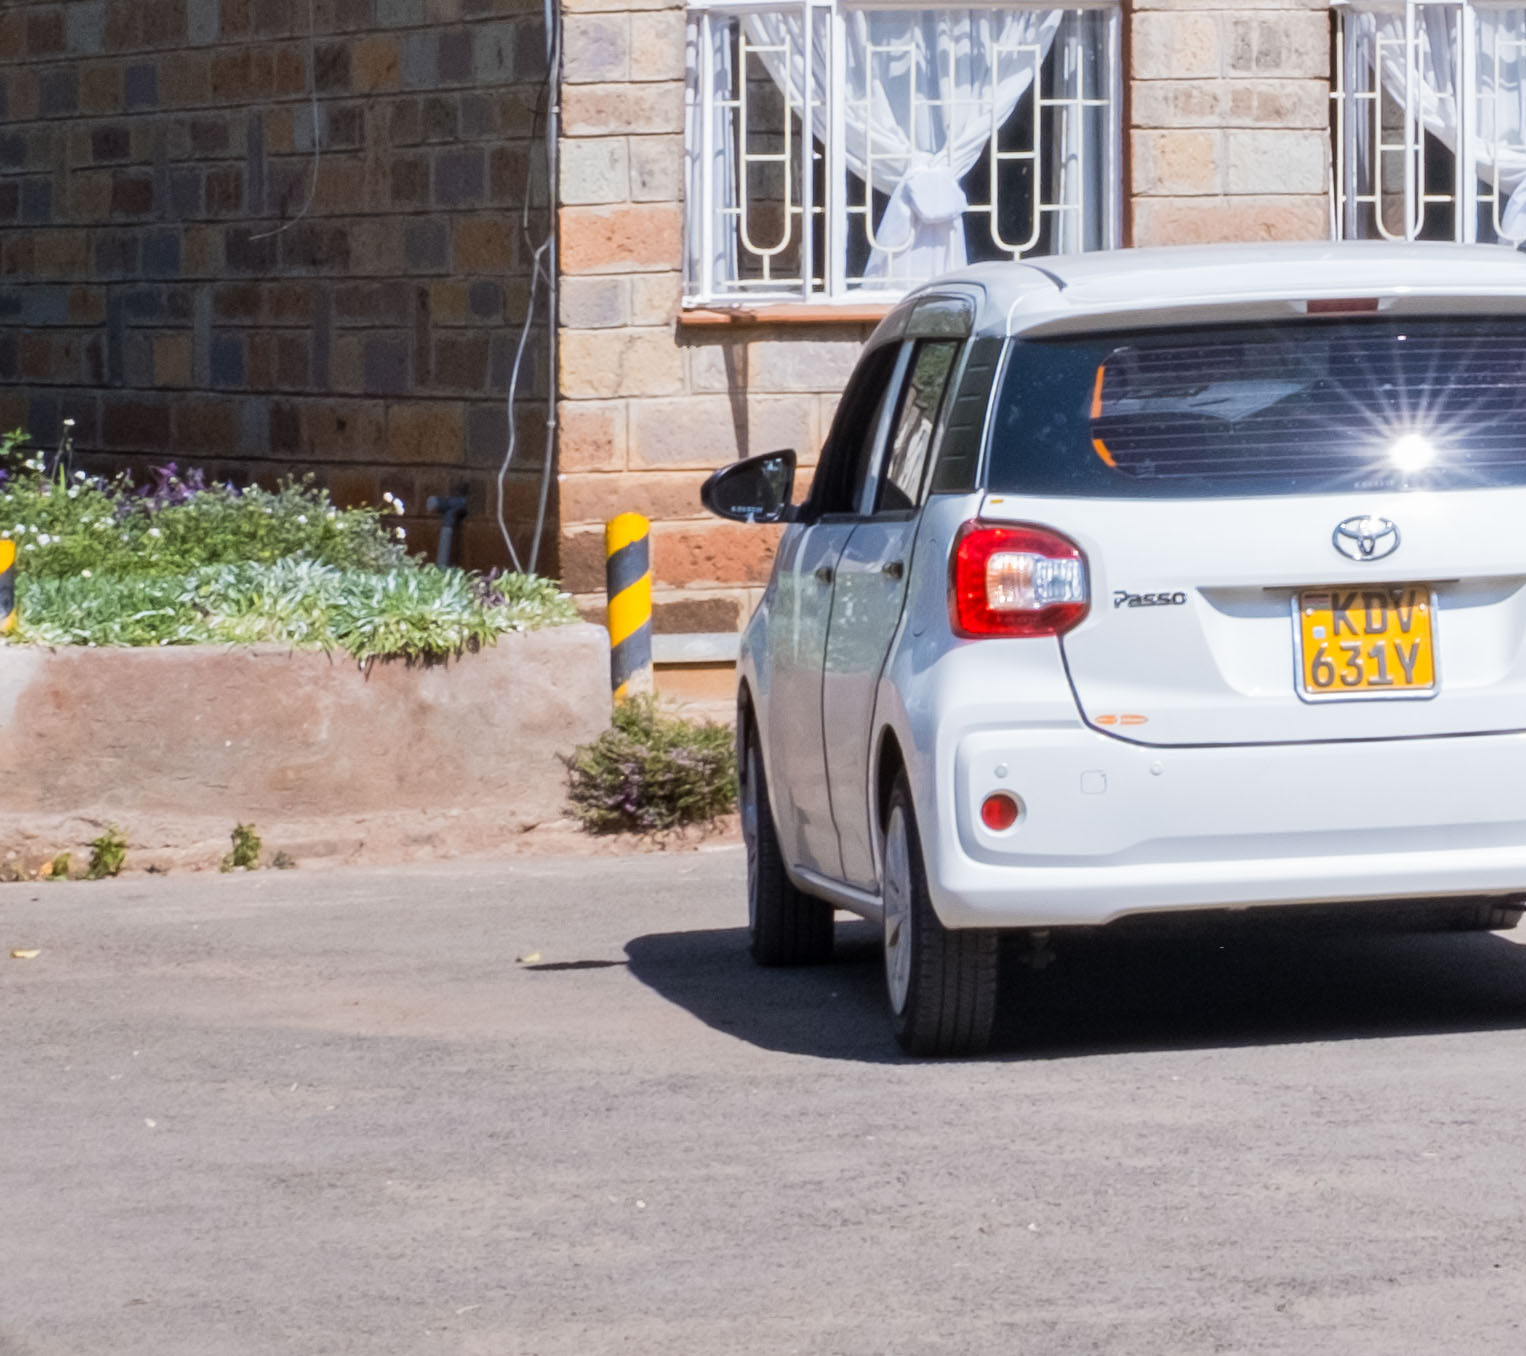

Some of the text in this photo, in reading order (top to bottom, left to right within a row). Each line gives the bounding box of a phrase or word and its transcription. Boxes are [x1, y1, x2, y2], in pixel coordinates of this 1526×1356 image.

[1112, 590, 1186, 608] Passo
[1331, 590, 1416, 636] KDV
[1311, 639, 1421, 687] 631Y
